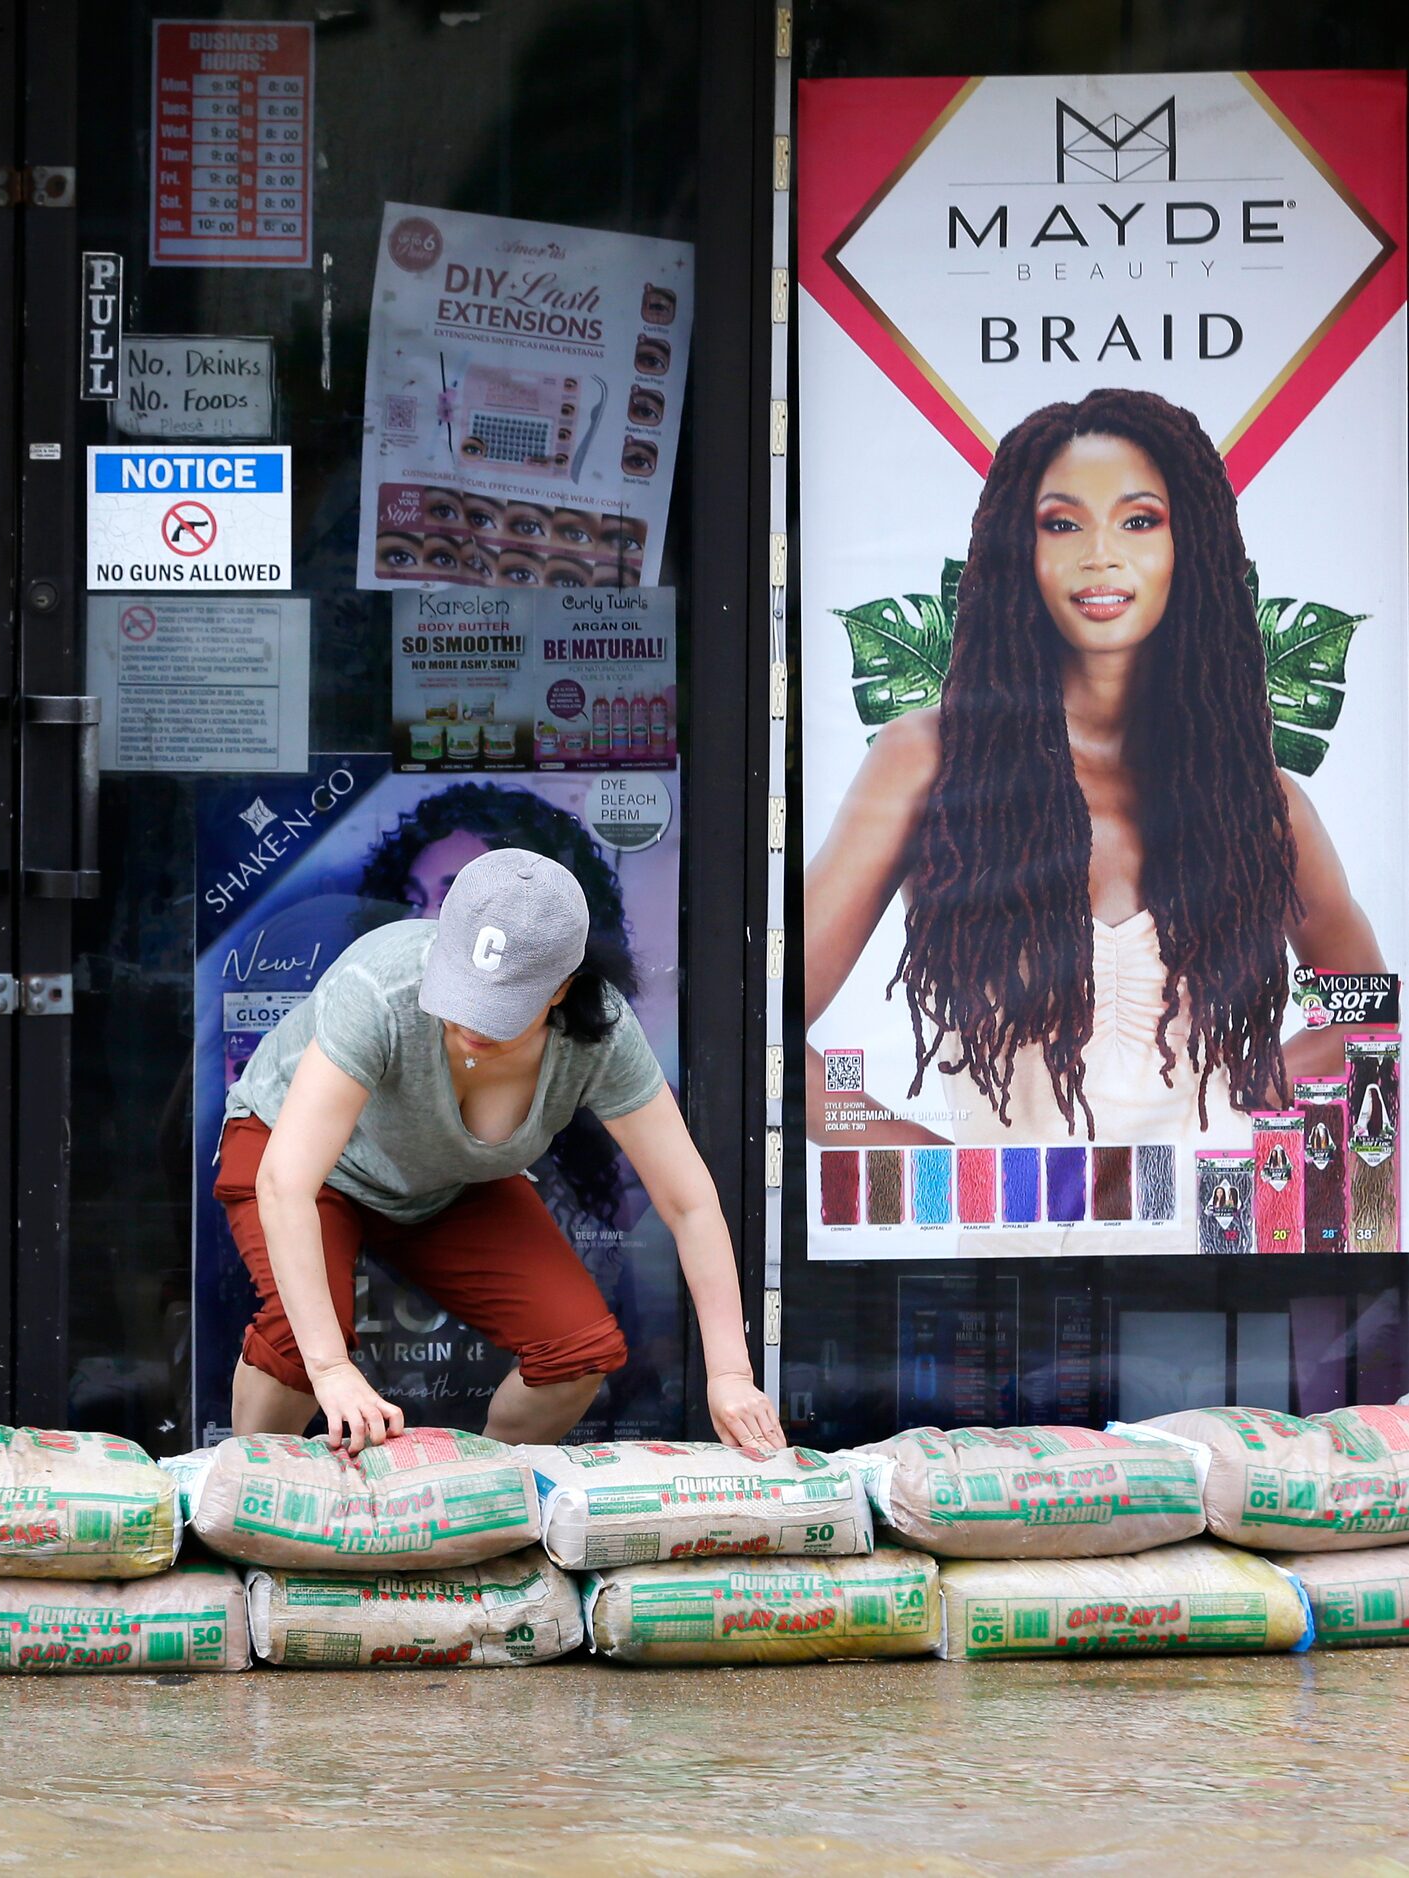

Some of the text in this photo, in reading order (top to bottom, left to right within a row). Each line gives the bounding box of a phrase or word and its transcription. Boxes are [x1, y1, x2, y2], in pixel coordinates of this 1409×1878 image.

[189, 32, 278, 50] BUSINESS
[1017, 261, 1215, 280] BEAUTY
[444, 263, 601, 313] DIY Lash
[89, 259, 116, 394] PULL
[437, 299, 603, 340] EXTENSIONS
[981, 313, 1244, 363] BRAID
[122, 458, 257, 488] NOTICE
[402, 490, 420, 499] FIND
[380, 507, 422, 525] Style
[97, 564, 281, 583] NO GUNS ALLOWED
[419, 595, 509, 619] Karelen
[562, 594, 647, 614] Curly Twirls
[418, 623, 509, 632] BODY BUTTER
[573, 622, 641, 631] ARGAN OIL
[402, 635, 522, 653] SO SMOOTH!
[544, 638, 664, 659] BE NATURAL!
[412, 660, 515, 670] NO MORE ASHY SKIN
[601, 779, 627, 790] DYE
[601, 794, 656, 805] BLEACH
[601, 810, 640, 820] PERM
[205, 768, 355, 914] SHAKE-N-GO
[222, 930, 321, 982] New!
[472, 926, 507, 972] C
[1319, 976, 1390, 991] MODERN
[1329, 992, 1387, 1009] SOFT
[1336, 1011, 1365, 1022] LOC
[825, 1111, 837, 1120] 3X
[840, 1111, 891, 1121] BOHEMIAN
[825, 1123, 850, 1132] (COLOR:
[575, 1231, 623, 1241] DEEP WAVE
[675, 1475, 761, 1493] QUIKRETE
[122, 1509, 151, 1528] 50
[805, 1524, 835, 1541] 50
[378, 1579, 464, 1596] QUIKRETE
[730, 1574, 824, 1590] QUIKRETE
[895, 1592, 923, 1608] 50
[28, 1606, 124, 1626] QUIKRETE
[722, 1608, 836, 1634] PLAY SAND
[193, 1626, 222, 1644] 50
[505, 1626, 534, 1642] 50
[19, 1643, 132, 1664] PLAY SAND
[371, 1642, 473, 1664] PLAY SAND
